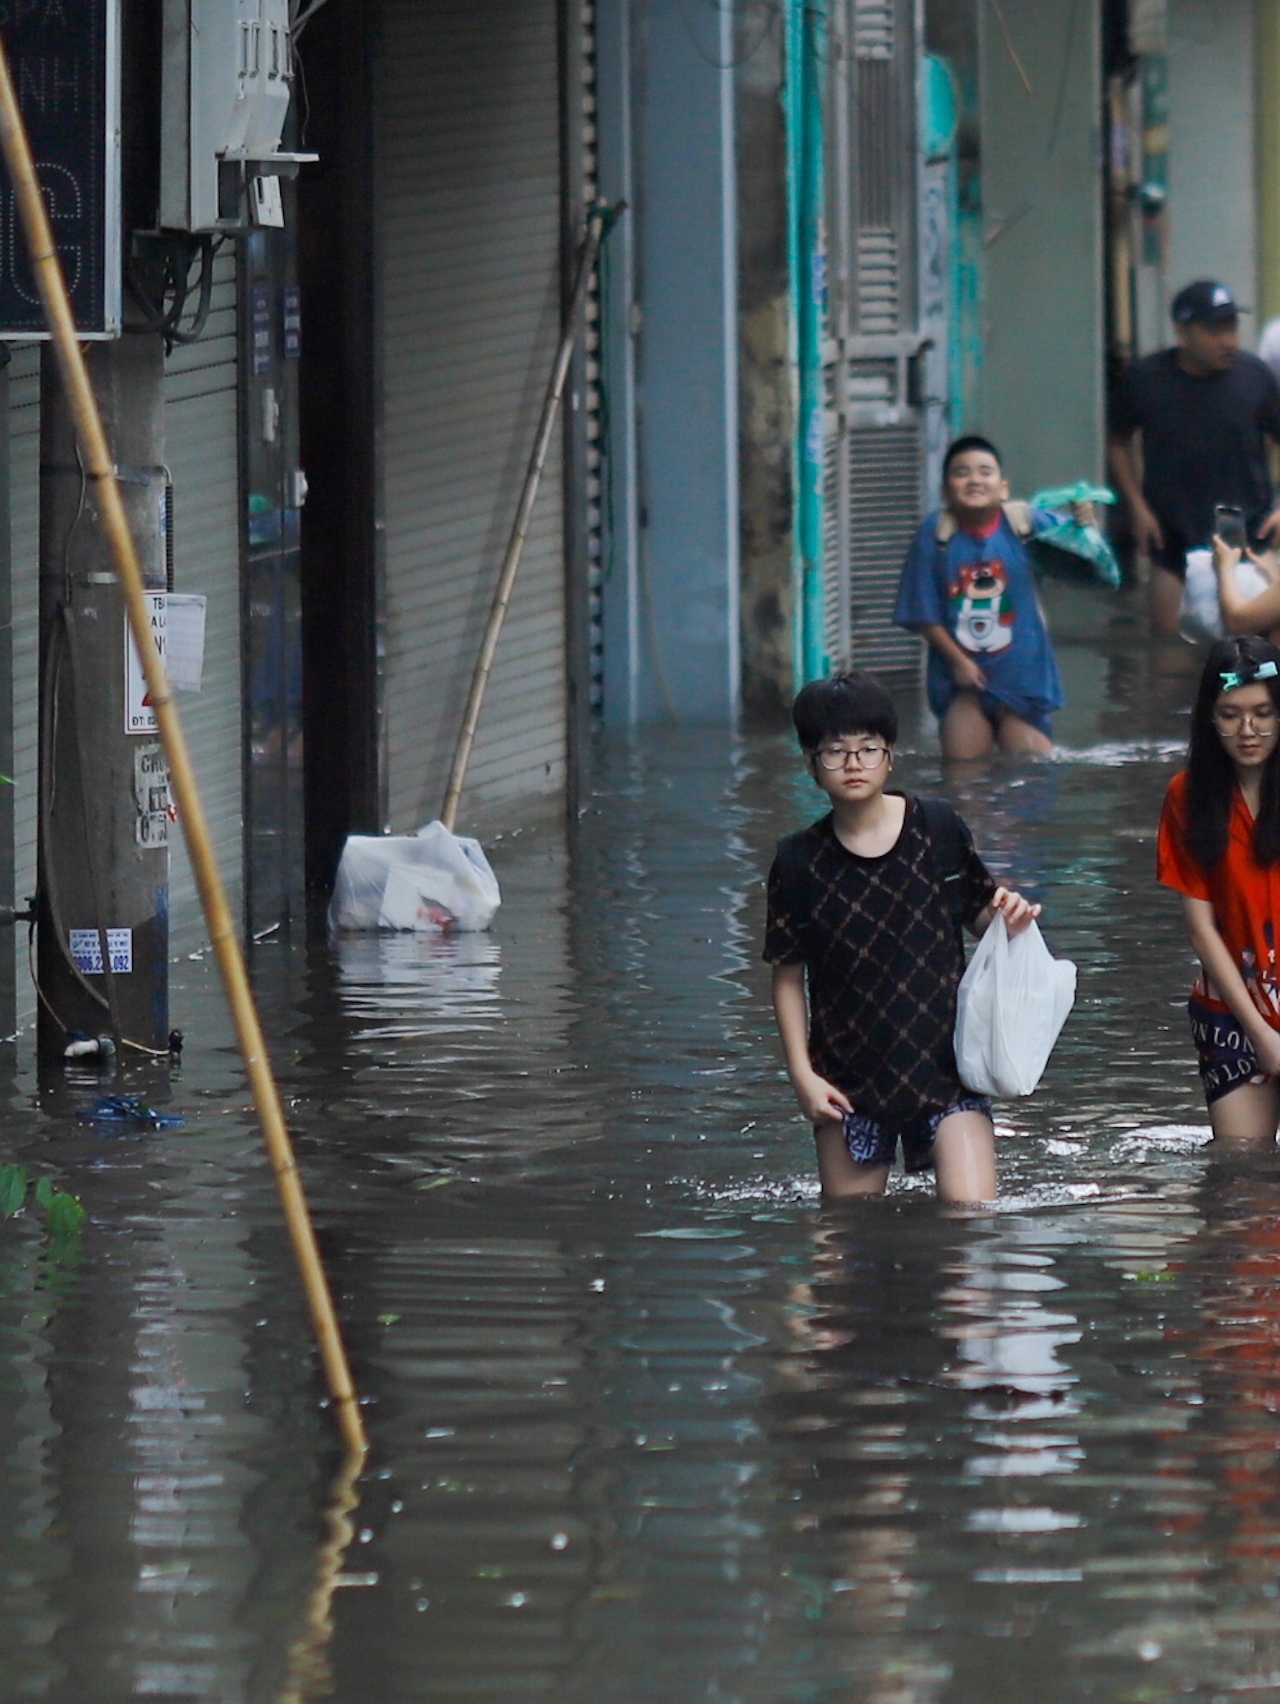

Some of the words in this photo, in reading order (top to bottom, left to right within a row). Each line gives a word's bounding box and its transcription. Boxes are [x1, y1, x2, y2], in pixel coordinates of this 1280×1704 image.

[8, 57, 79, 112] NH
[153, 597, 166, 610] TB
[1213, 1026, 1255, 1054] LON
